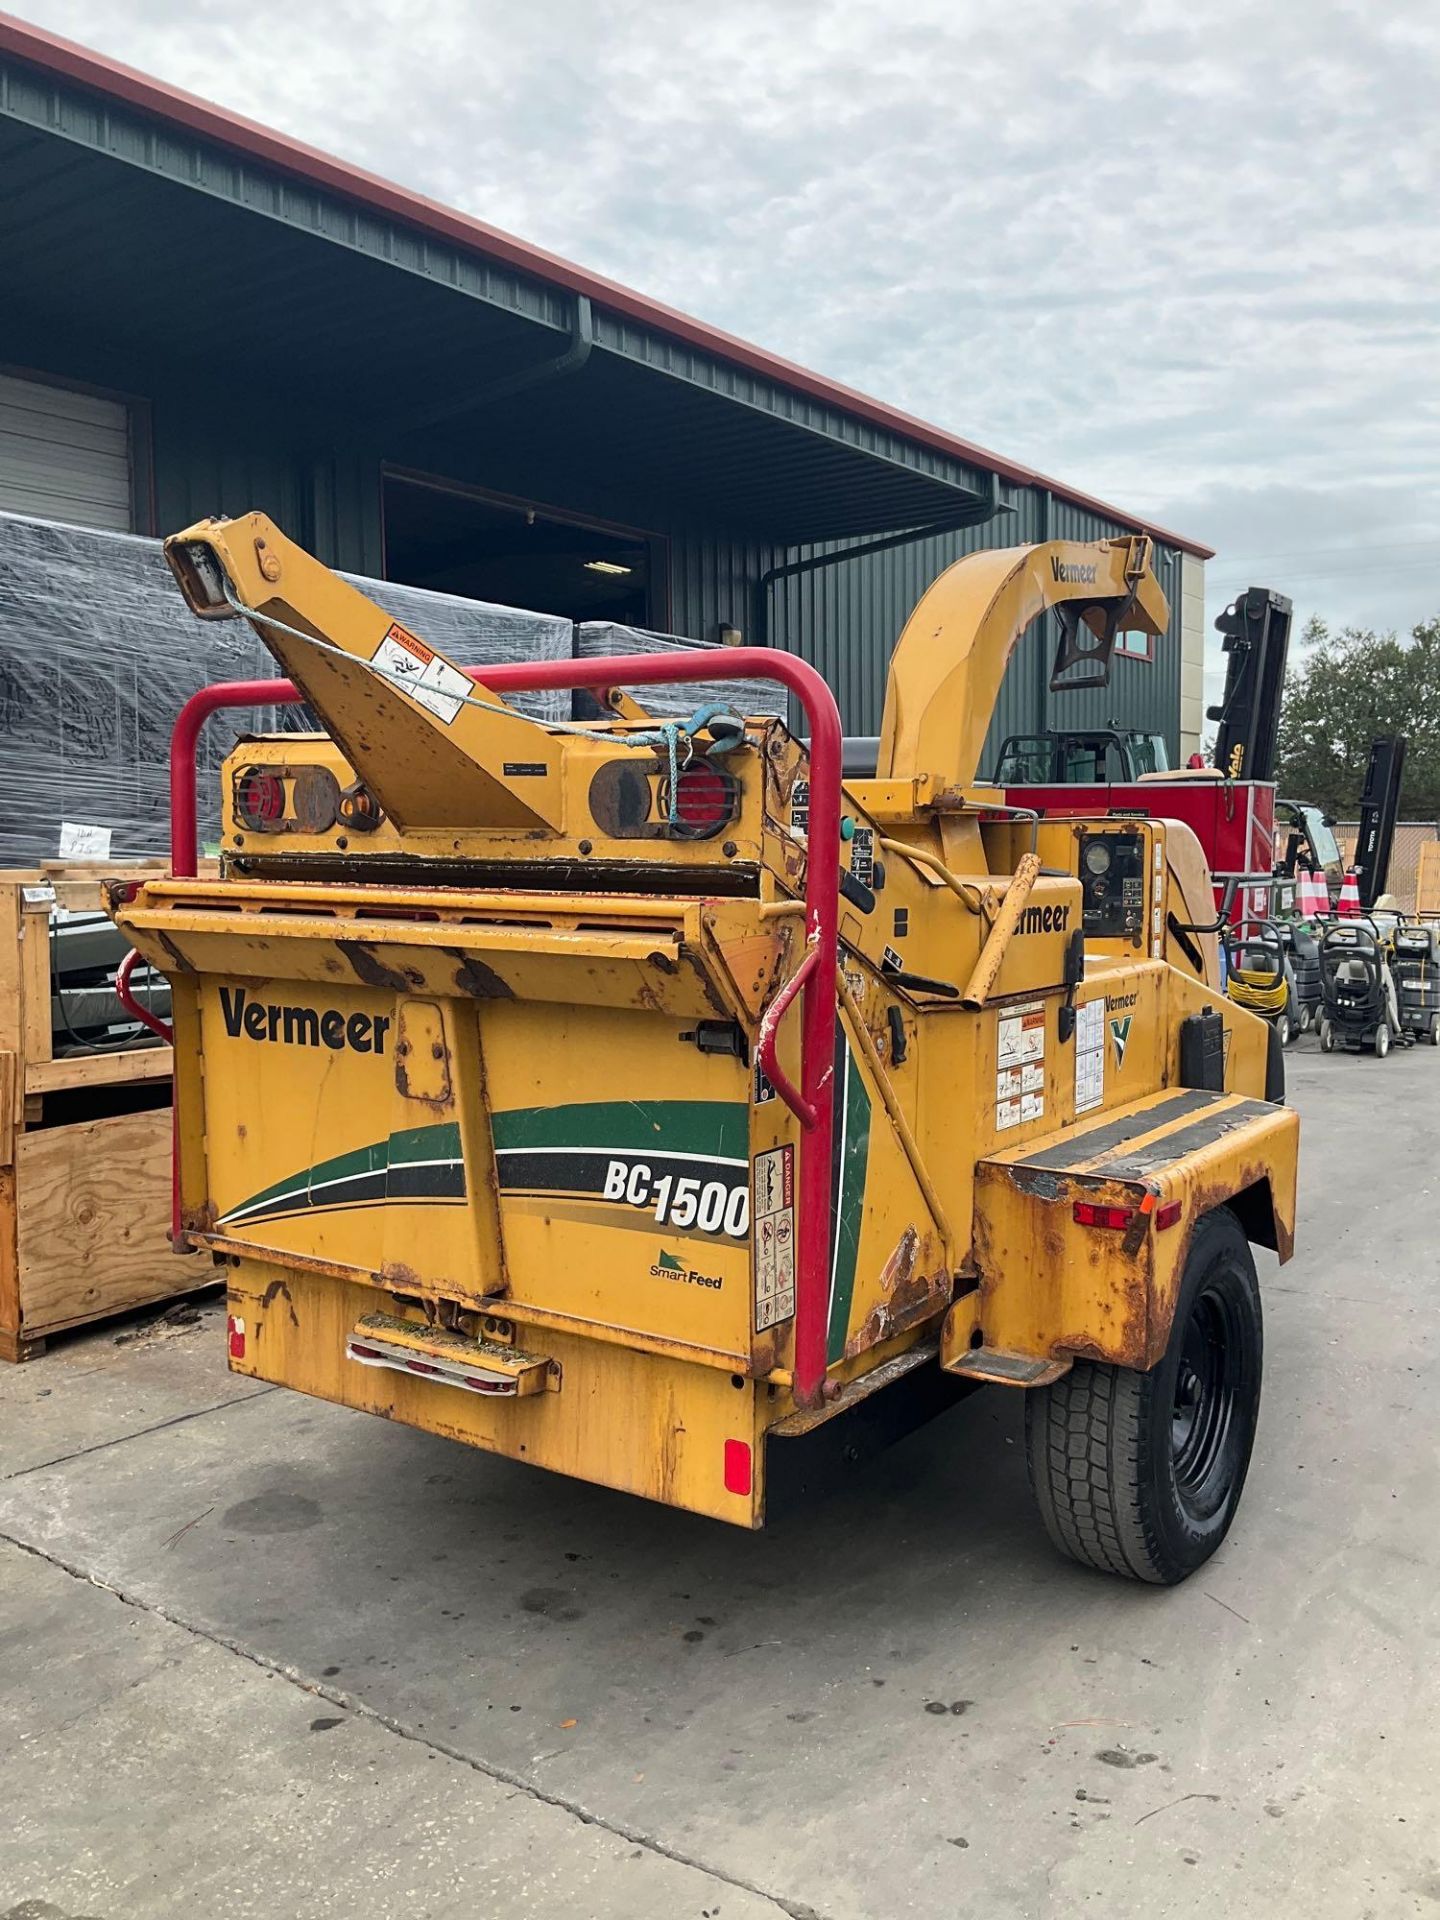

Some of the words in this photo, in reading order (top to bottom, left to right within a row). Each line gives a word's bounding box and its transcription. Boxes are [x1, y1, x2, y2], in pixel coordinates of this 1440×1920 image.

[1051, 556, 1096, 584] Vermeer
[399, 634, 431, 662] WARNING
[1368, 830, 1376, 852] TOYOTA
[1012, 905, 1070, 936] rmeer
[1105, 993, 1137, 1012] Vermeer
[219, 986, 390, 1054] Vermeer
[603, 1161, 750, 1238] BC1500
